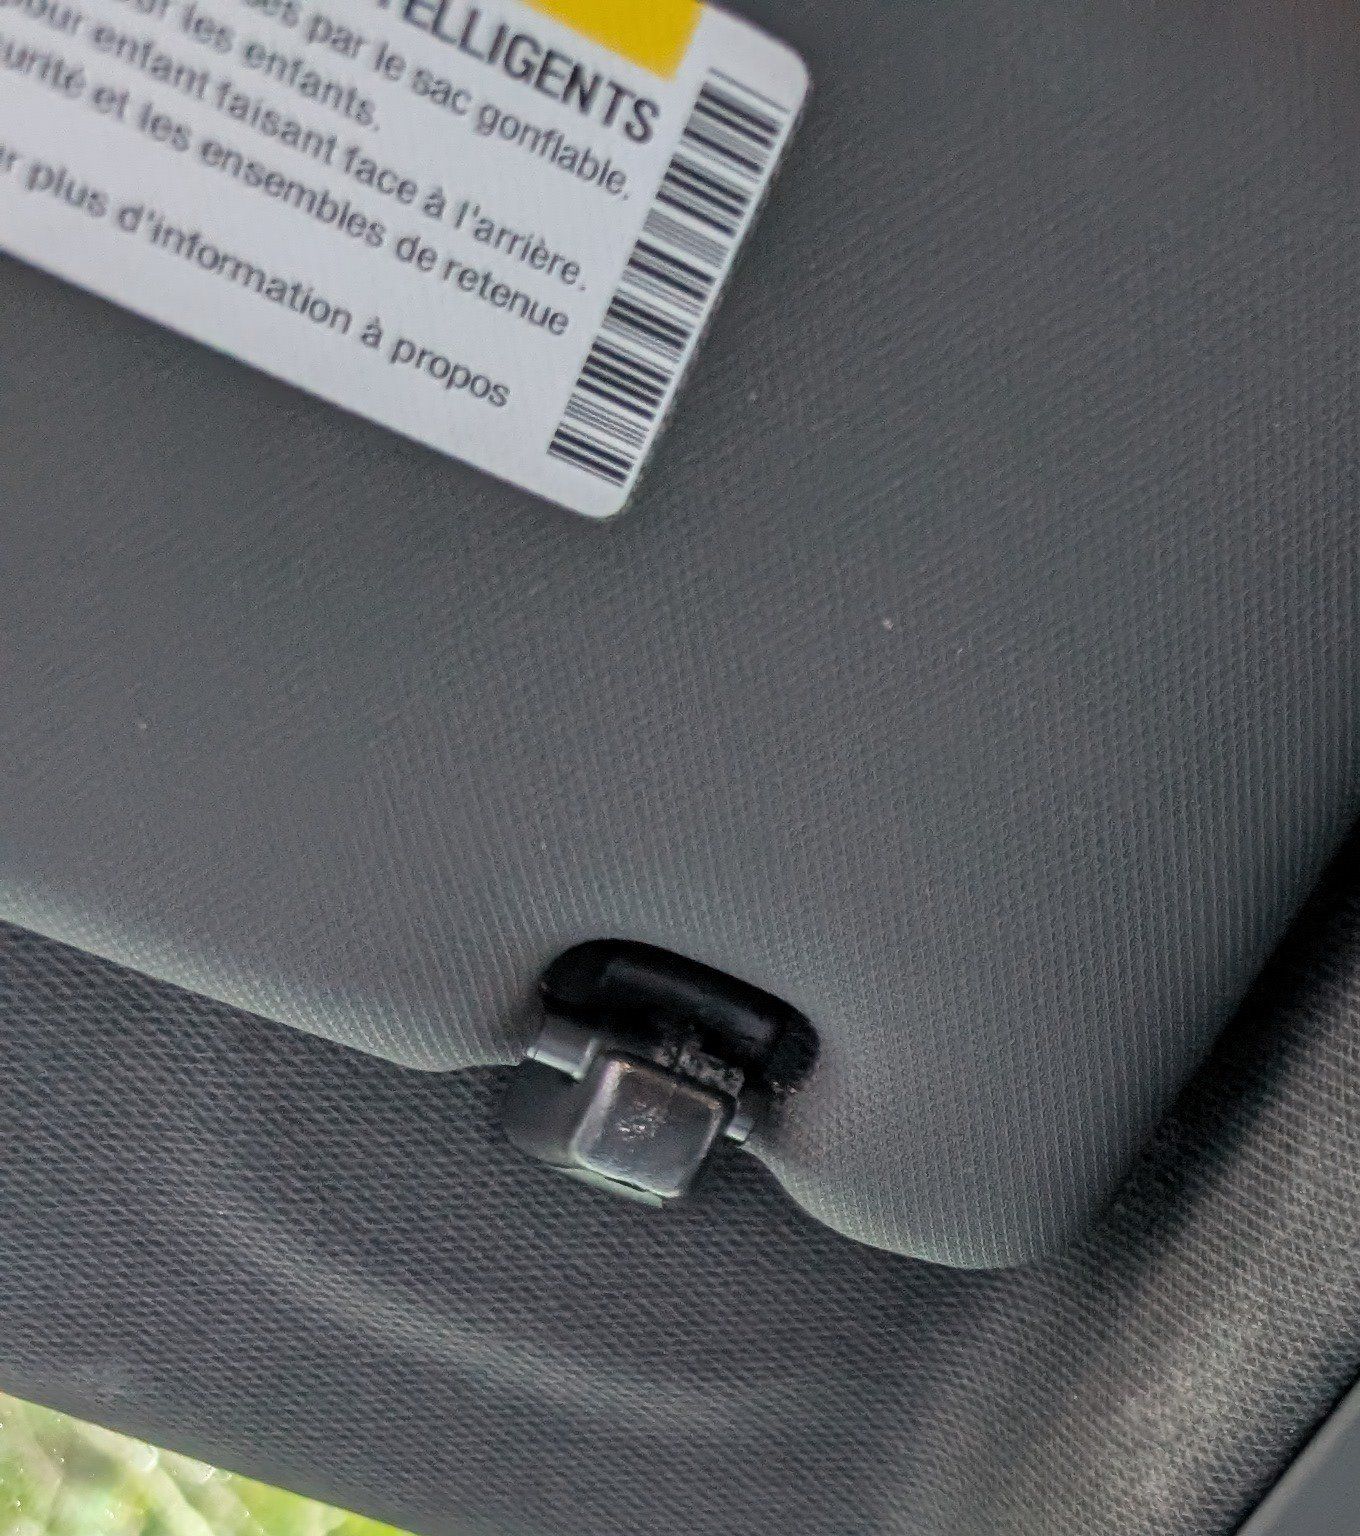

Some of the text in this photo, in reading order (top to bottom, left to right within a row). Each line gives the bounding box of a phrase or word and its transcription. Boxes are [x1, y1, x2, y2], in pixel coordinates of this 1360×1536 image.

[0, 0, 83, 35] our
[92, 24, 210, 100] enfant
[216, 81, 338, 165] faisant
[343, 145, 419, 205] face
[422, 185, 447, 220] à
[181, 5, 234, 52] les
[242, 41, 380, 132] enfants.
[304, 13, 367, 59] par
[374, 41, 406, 81] le
[411, 65, 473, 117] sac
[474, 103, 629, 200] gonflable.
[376, 0, 661, 144] ELLIGENTS
[3, 39, 570, 336] urité et les ensembles de retenue
[26, 160, 511, 408] plus d'information à propos
